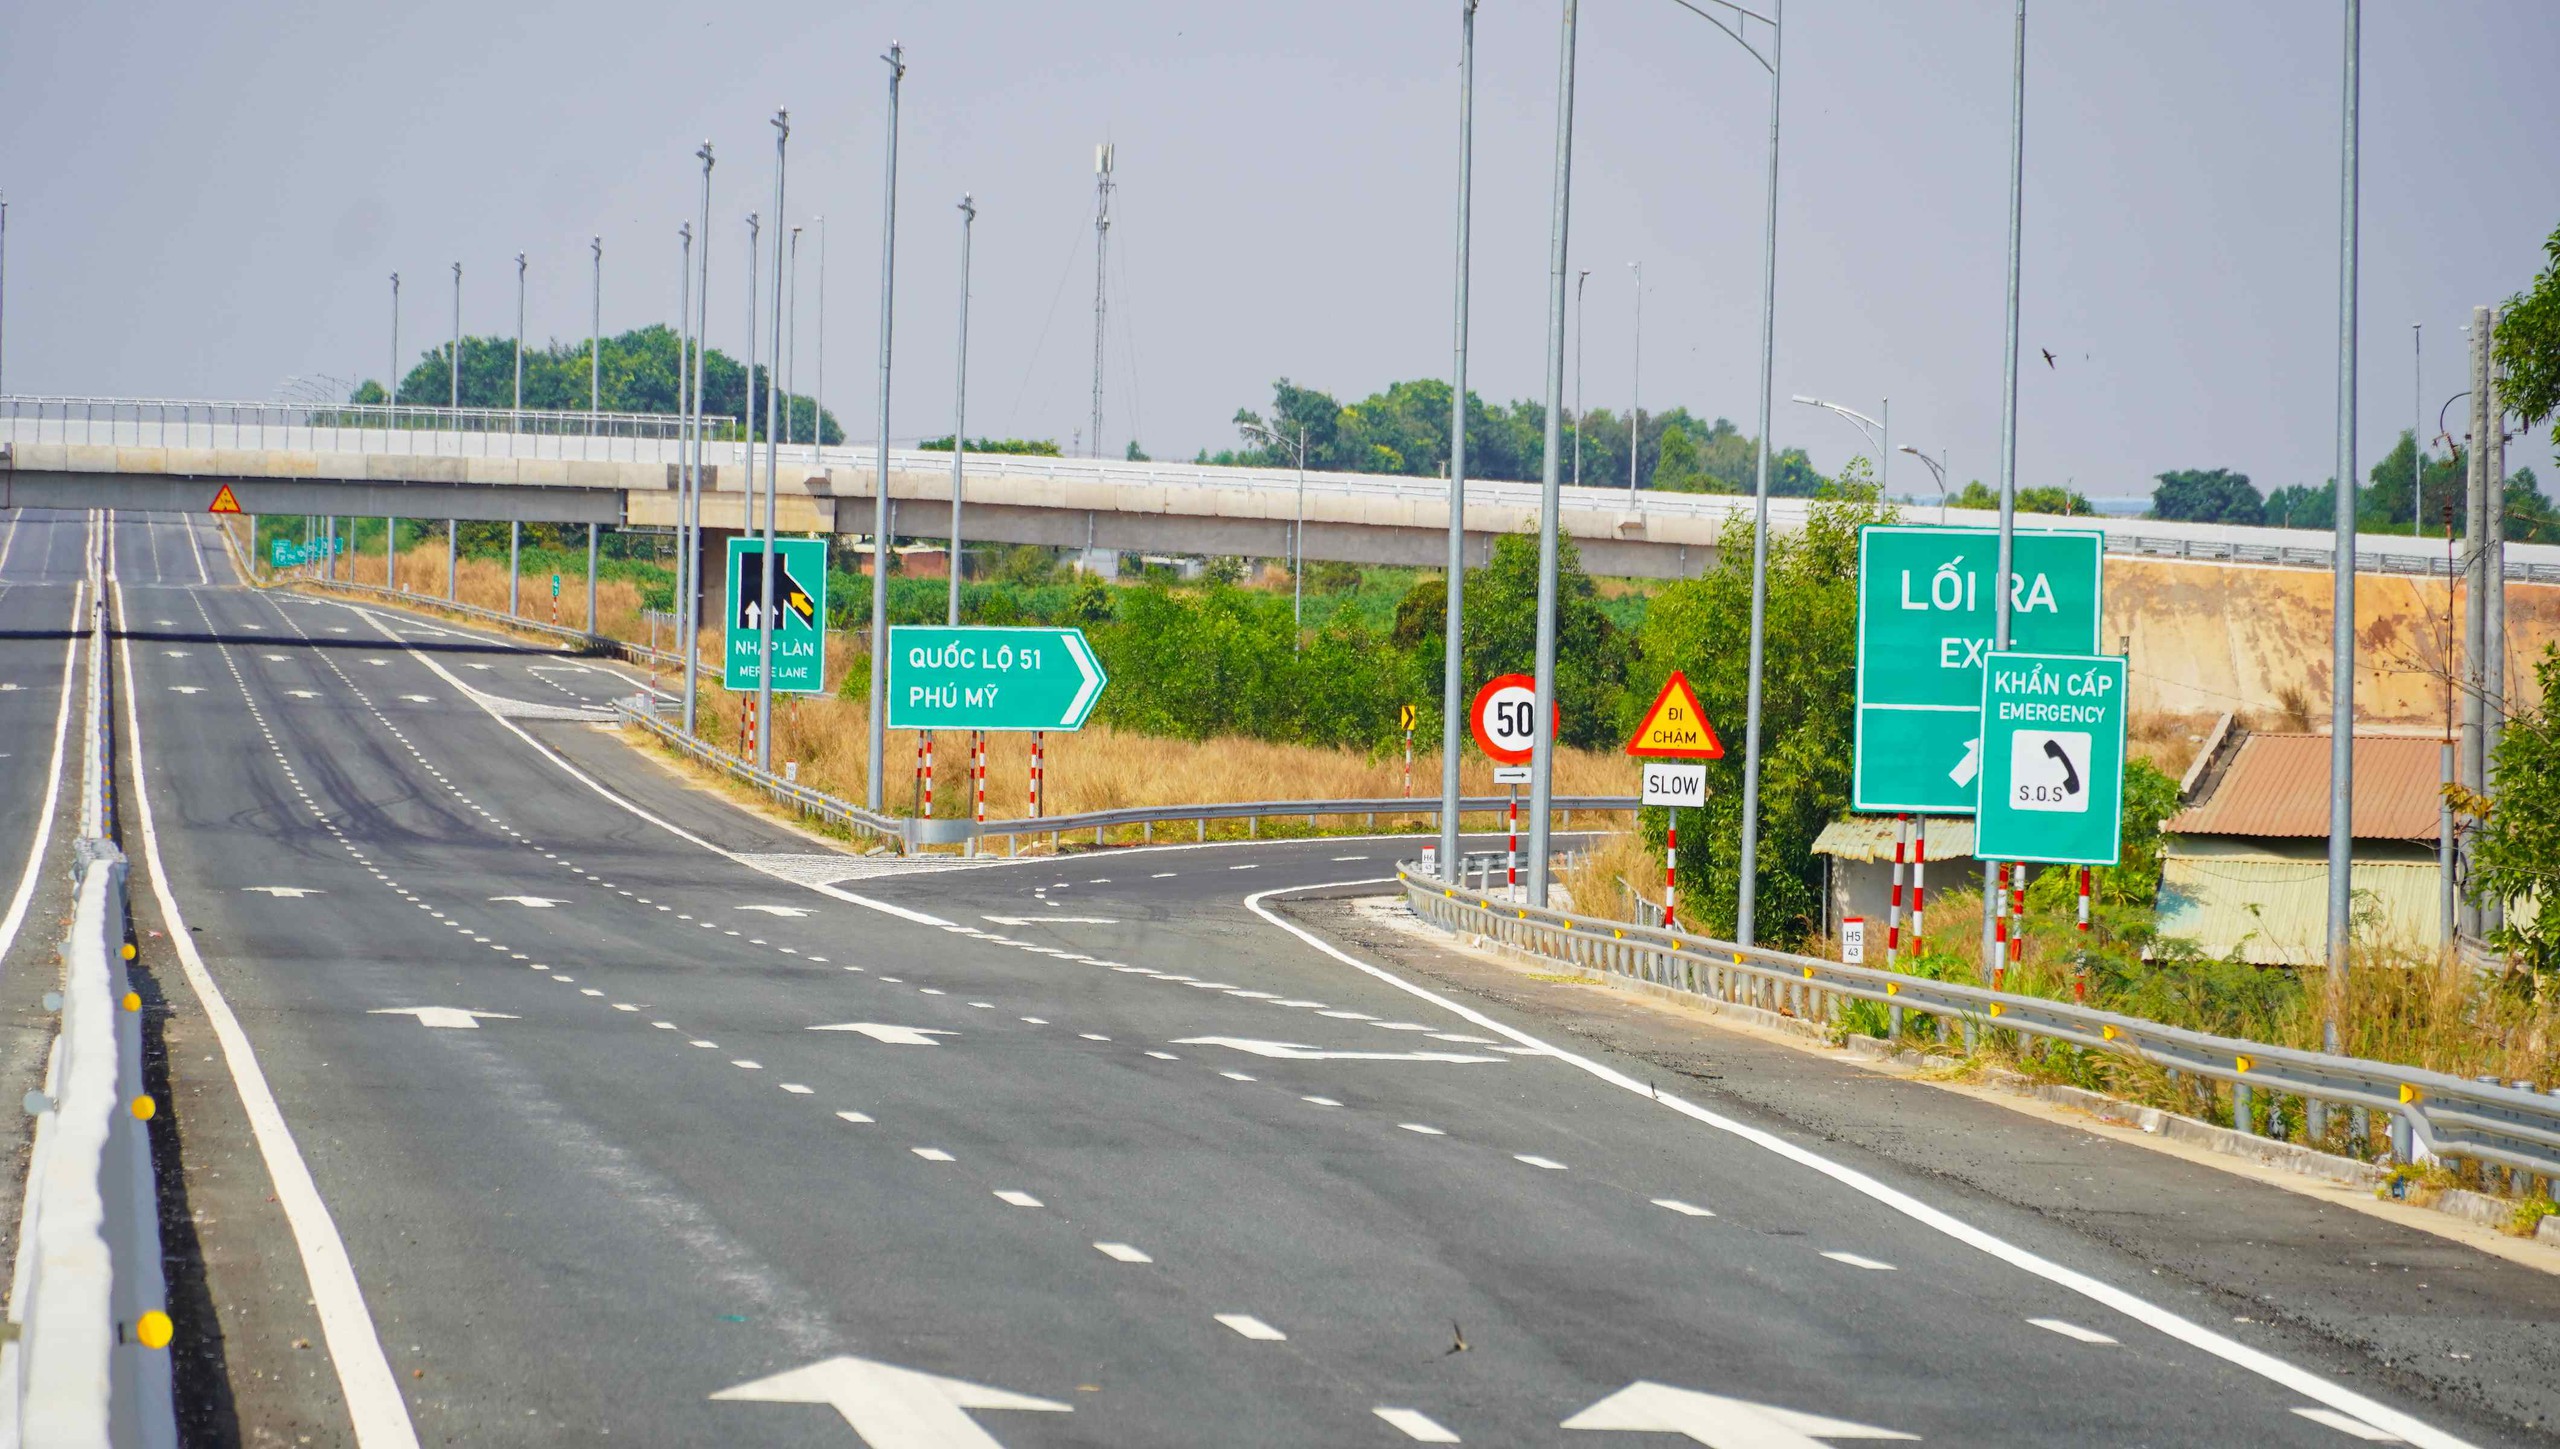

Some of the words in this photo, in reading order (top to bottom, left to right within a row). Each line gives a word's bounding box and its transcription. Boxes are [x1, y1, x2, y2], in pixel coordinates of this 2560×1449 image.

[1901, 555, 1976, 611] LỐI
[1995, 572, 2058, 613] RA
[735, 639, 779, 656] NHP
[782, 638, 814, 657] LÀN
[909, 639, 976, 669] QUỐC
[982, 644, 1013, 673] LỘ
[1020, 648, 1041, 670] 51
[778, 666, 808, 679] LANE
[1994, 662, 2060, 696] KHẨN
[2066, 666, 2113, 697] CẤP
[909, 681, 958, 709] PHÚ
[964, 683, 999, 709] MỸ
[1497, 701, 1534, 738] 50
[1668, 707, 1683, 721] ĐI
[1999, 701, 2106, 723] EMERGENCY
[1653, 727, 1697, 747] CHẬM
[1649, 774, 1699, 796] SLOW
[2019, 785, 2063, 802] S.O.S
[1846, 931, 1861, 942] H5
[1848, 947, 1859, 956] 43
